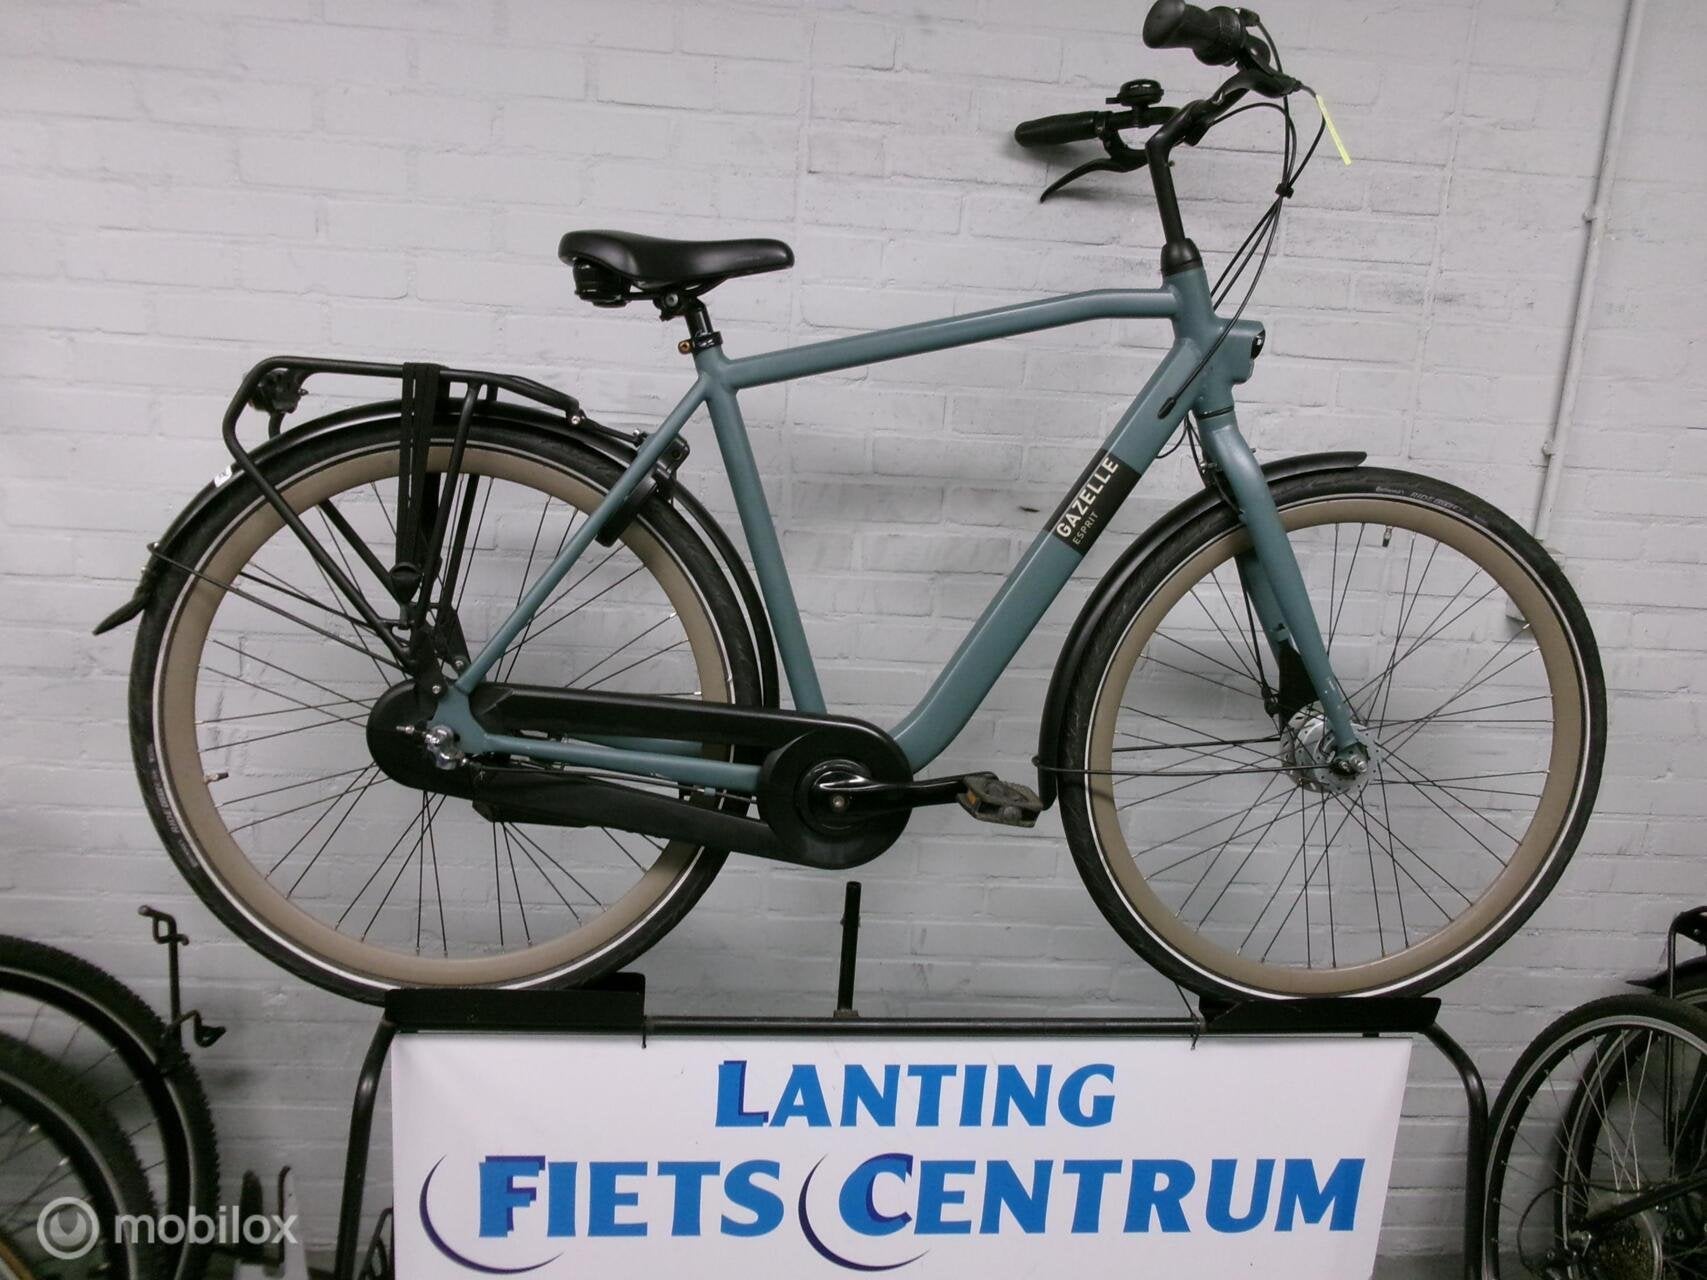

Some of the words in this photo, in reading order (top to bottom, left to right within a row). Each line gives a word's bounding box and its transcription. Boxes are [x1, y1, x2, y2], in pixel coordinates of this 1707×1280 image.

[1056, 457, 1119, 537] GAZELLE
[1072, 511, 1098, 544] ESPRIT
[716, 1060, 1115, 1128] LANTING
[479, 1155, 785, 1238] FIETS
[838, 1152, 1365, 1237] CENTRUM
